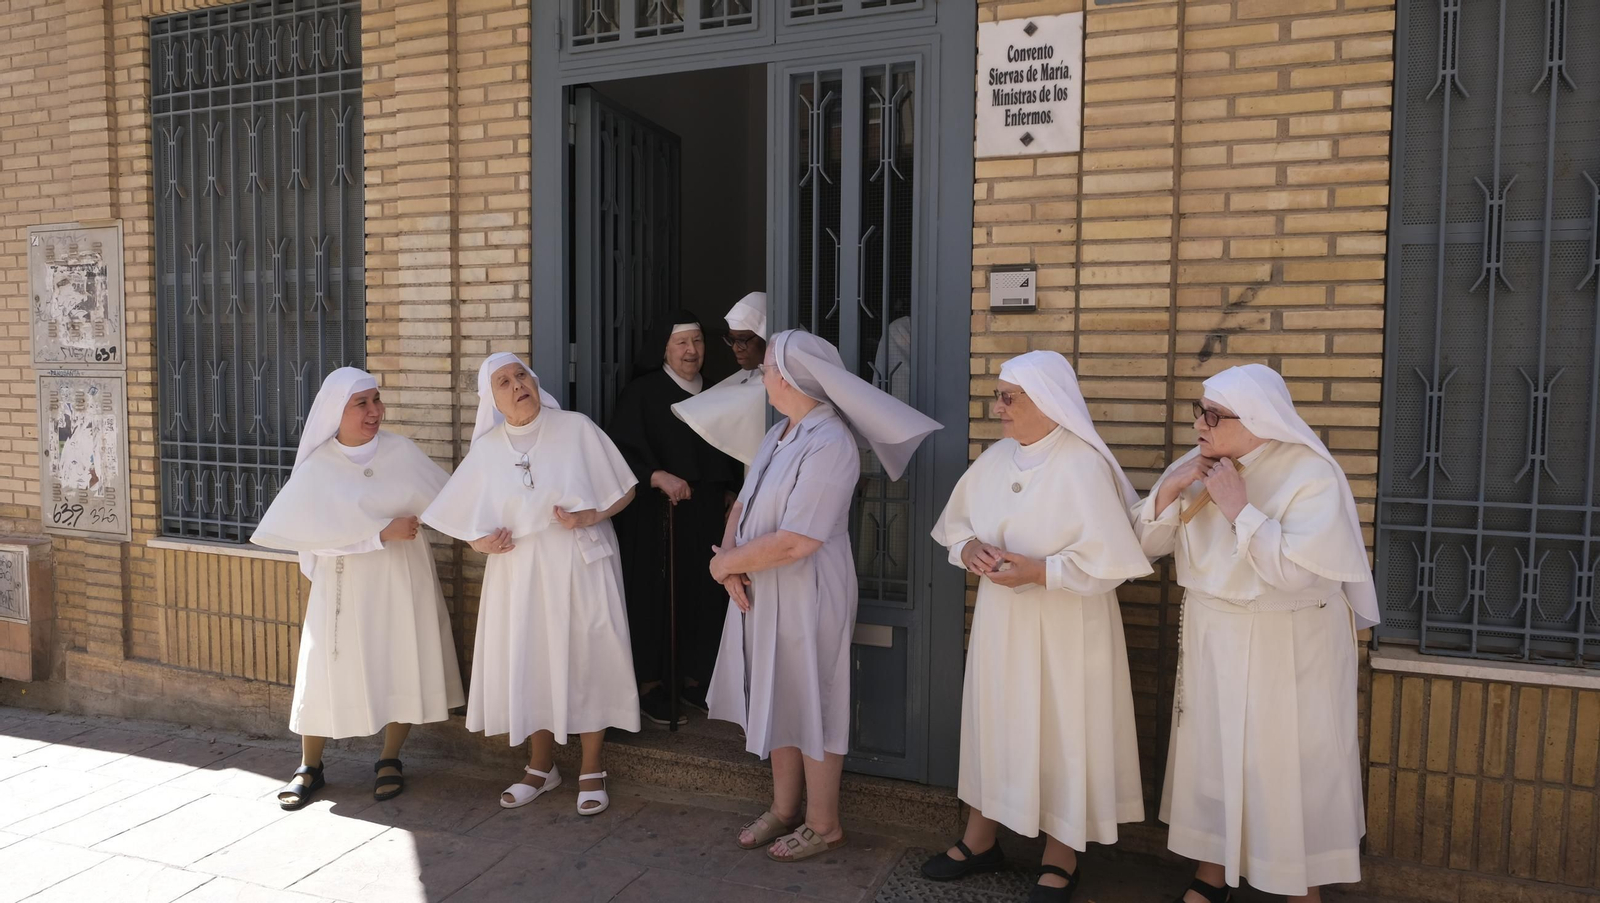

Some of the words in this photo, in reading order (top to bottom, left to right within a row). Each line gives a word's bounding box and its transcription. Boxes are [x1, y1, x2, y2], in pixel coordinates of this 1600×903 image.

[1007, 43, 1054, 63] Convento
[989, 67, 1024, 86] Siervas
[1026, 65, 1038, 82] de
[1040, 60, 1072, 81] María,
[992, 87, 1037, 107] Ministras
[1039, 85, 1051, 103] de
[1053, 84, 1068, 102] los
[1004, 108, 1054, 127] Enfermos.
[94, 345, 117, 362] 639
